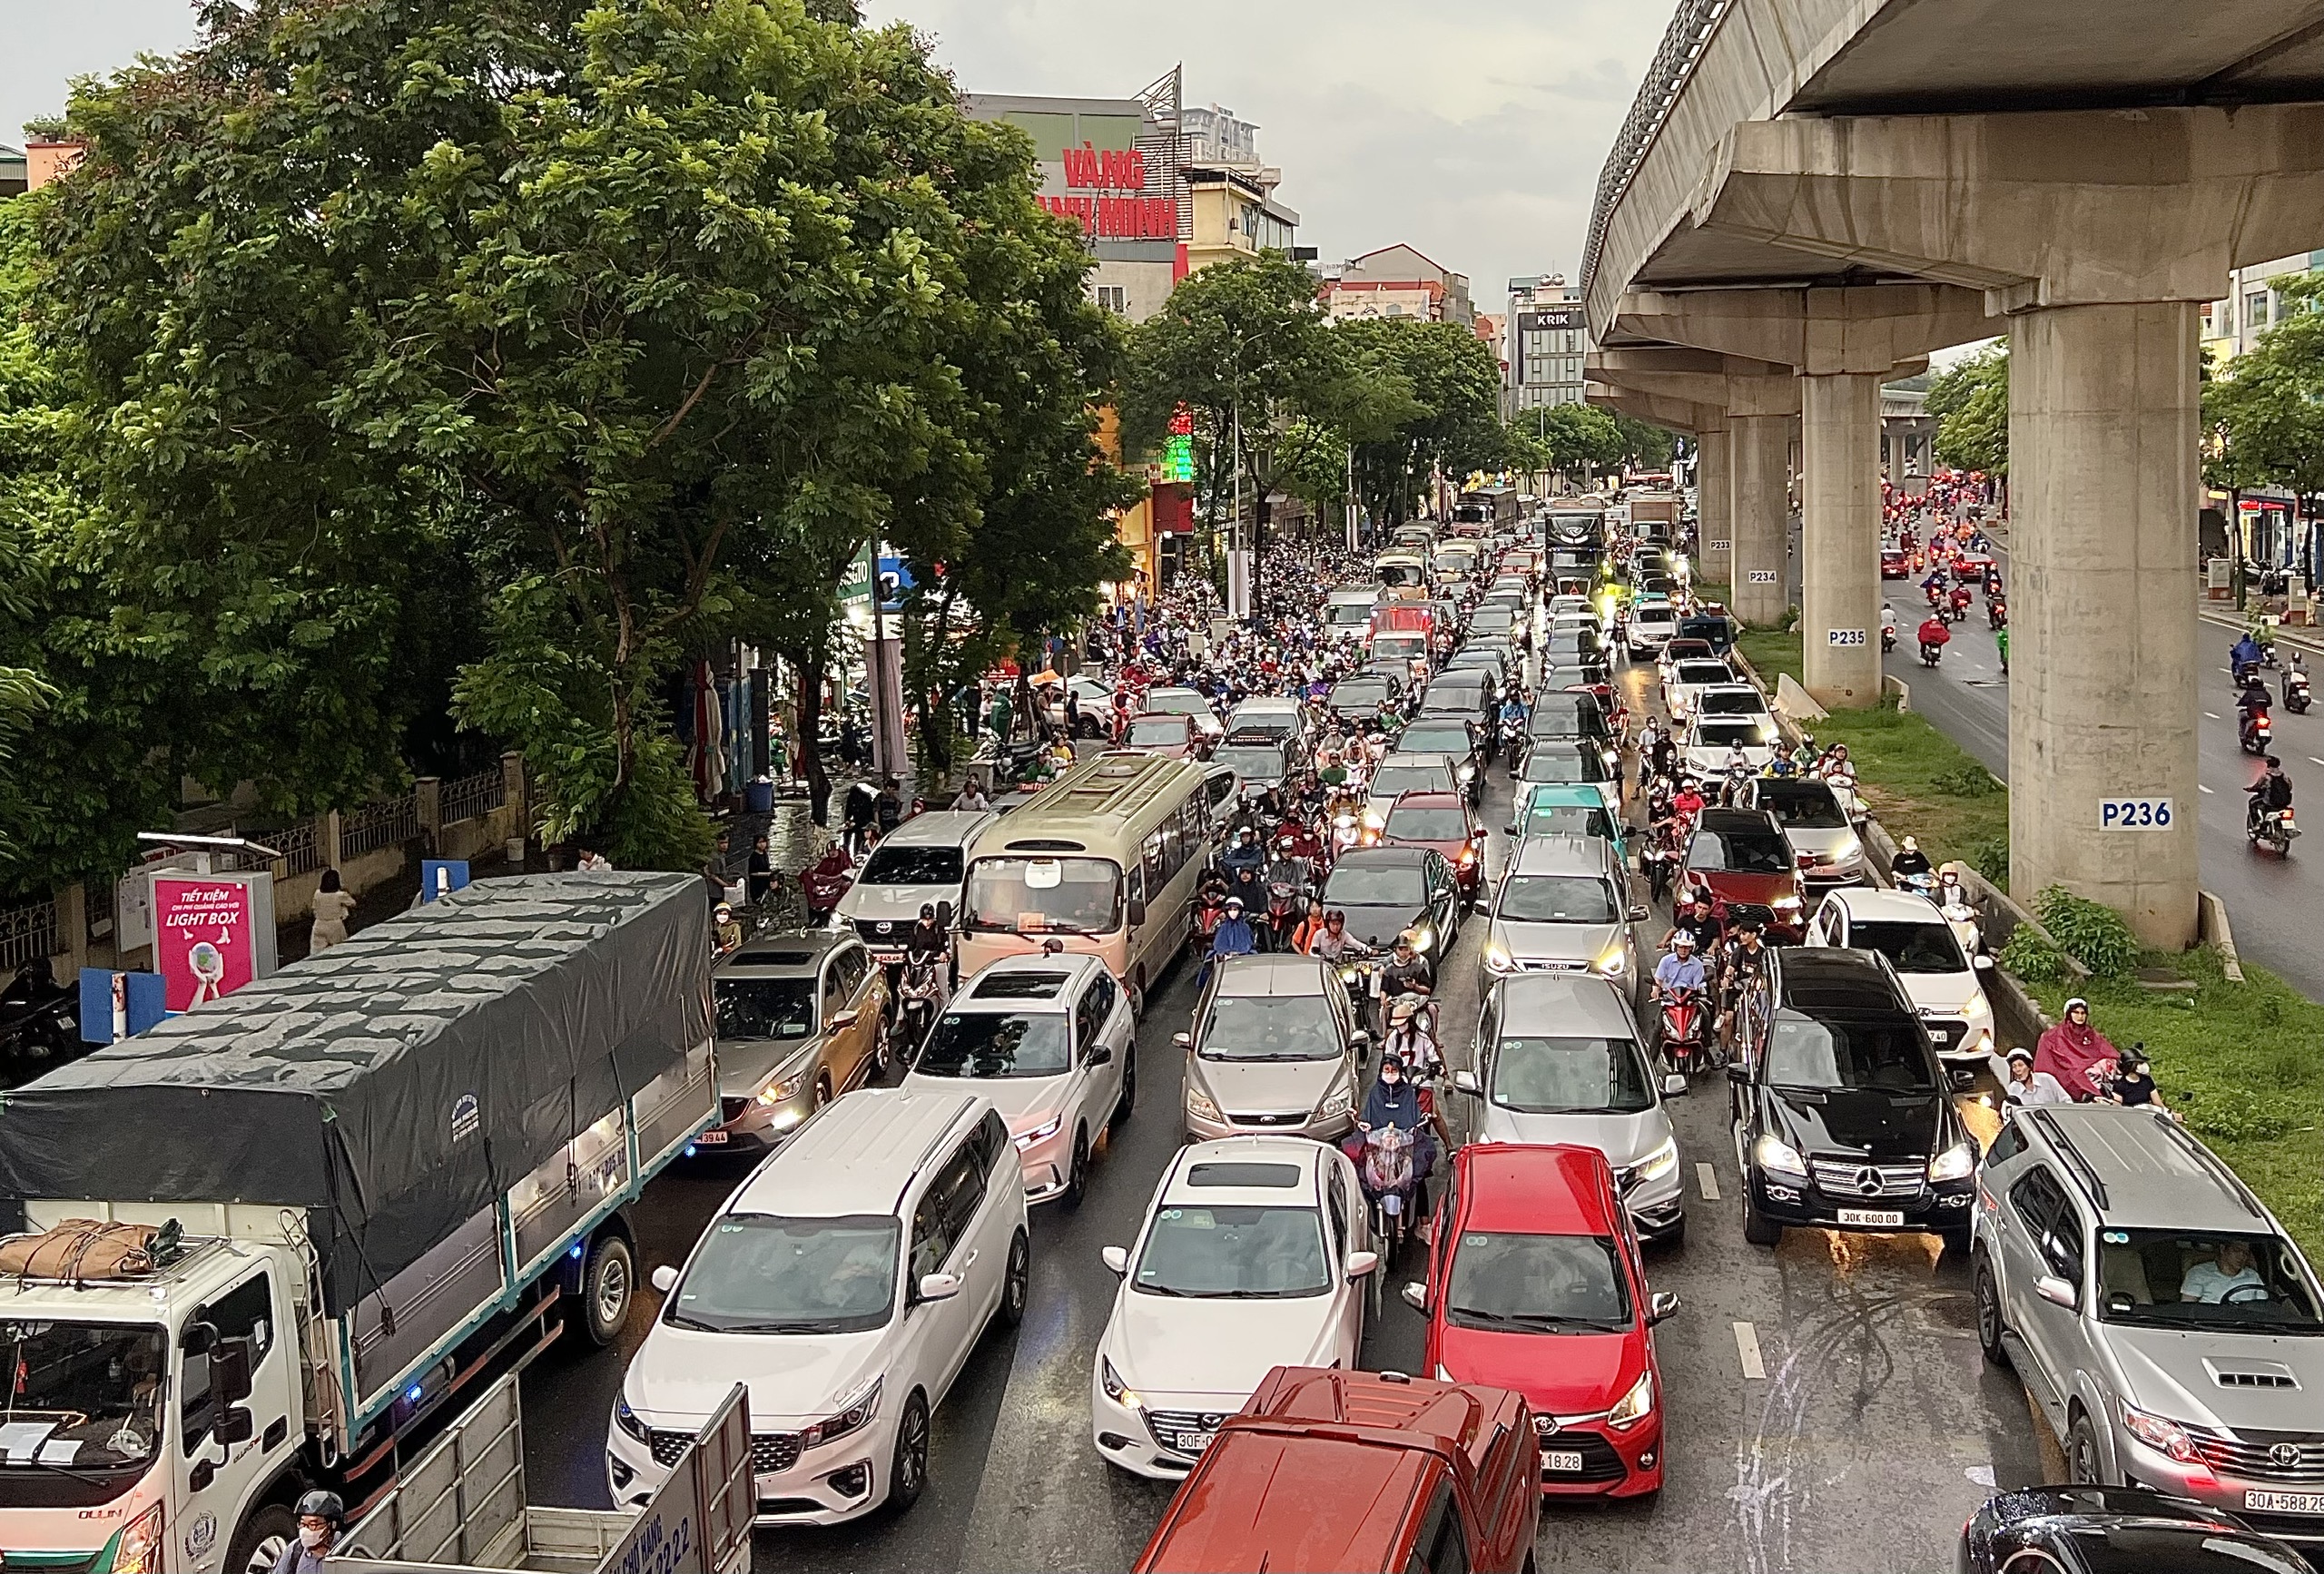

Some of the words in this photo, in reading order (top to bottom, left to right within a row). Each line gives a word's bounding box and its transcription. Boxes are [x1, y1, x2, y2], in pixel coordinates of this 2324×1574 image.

[1062, 141, 1144, 189] VÀNG
[1098, 198, 1177, 237] MINH
[1537, 314, 1569, 325] KRIK
[1710, 541, 1730, 549] P233
[1749, 572, 1776, 582] P234
[1830, 630, 1865, 644] P235
[2103, 802, 2171, 827] P236
[182, 888, 202, 902] TIẾT
[202, 888, 229, 903] KIỆM
[166, 913, 208, 926] LIGHT
[208, 911, 240, 925] BOX
